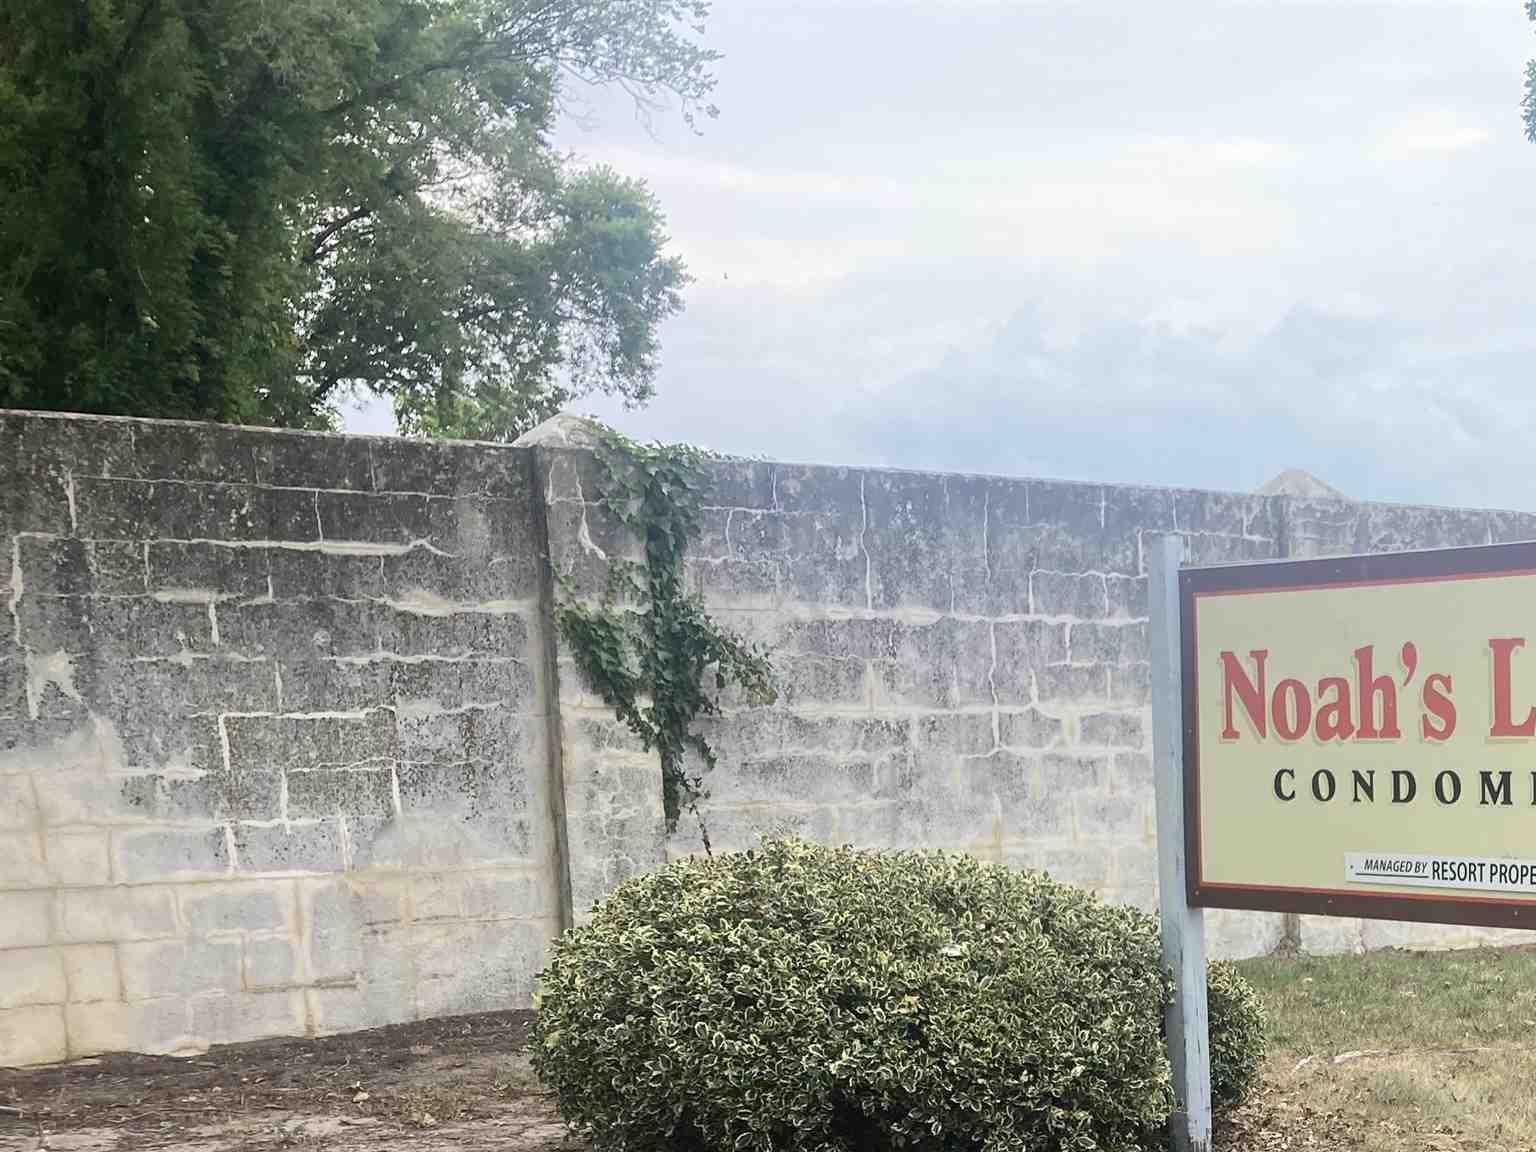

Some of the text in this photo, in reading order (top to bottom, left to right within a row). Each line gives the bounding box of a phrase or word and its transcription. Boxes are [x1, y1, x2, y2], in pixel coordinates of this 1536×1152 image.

[1218, 641, 1457, 743] Noah's
[1364, 858, 1412, 873] MANAGED
[1414, 861, 1428, 874] BY
[1432, 861, 1485, 883] RESORT
